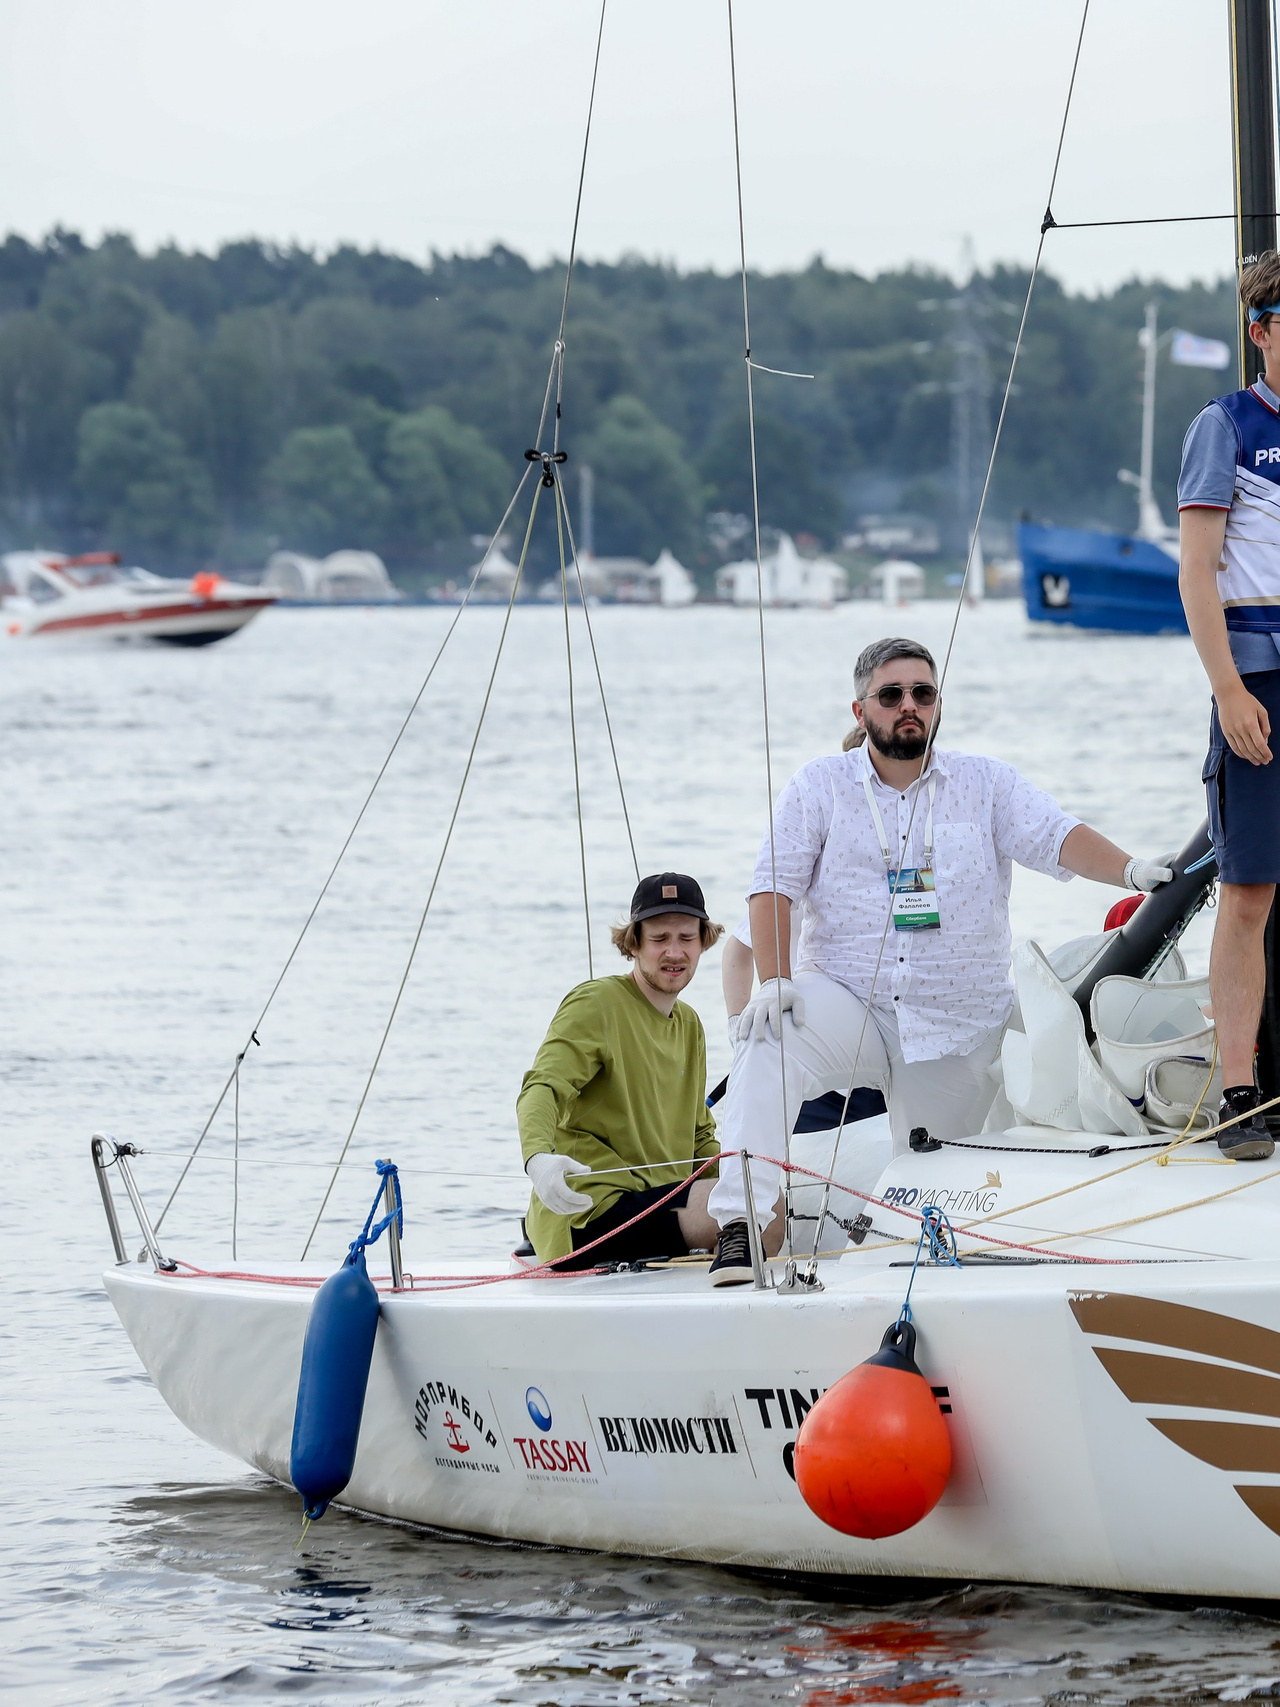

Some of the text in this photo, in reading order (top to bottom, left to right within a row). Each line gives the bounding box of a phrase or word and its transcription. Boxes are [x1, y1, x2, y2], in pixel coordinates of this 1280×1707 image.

[881, 1186, 998, 1213] PROYACHTING
[414, 1381, 498, 1448] МОРПРИБОР
[513, 1437, 591, 1473] TASSAY
[597, 1416, 739, 1458] ВЕДОМОСТИ
